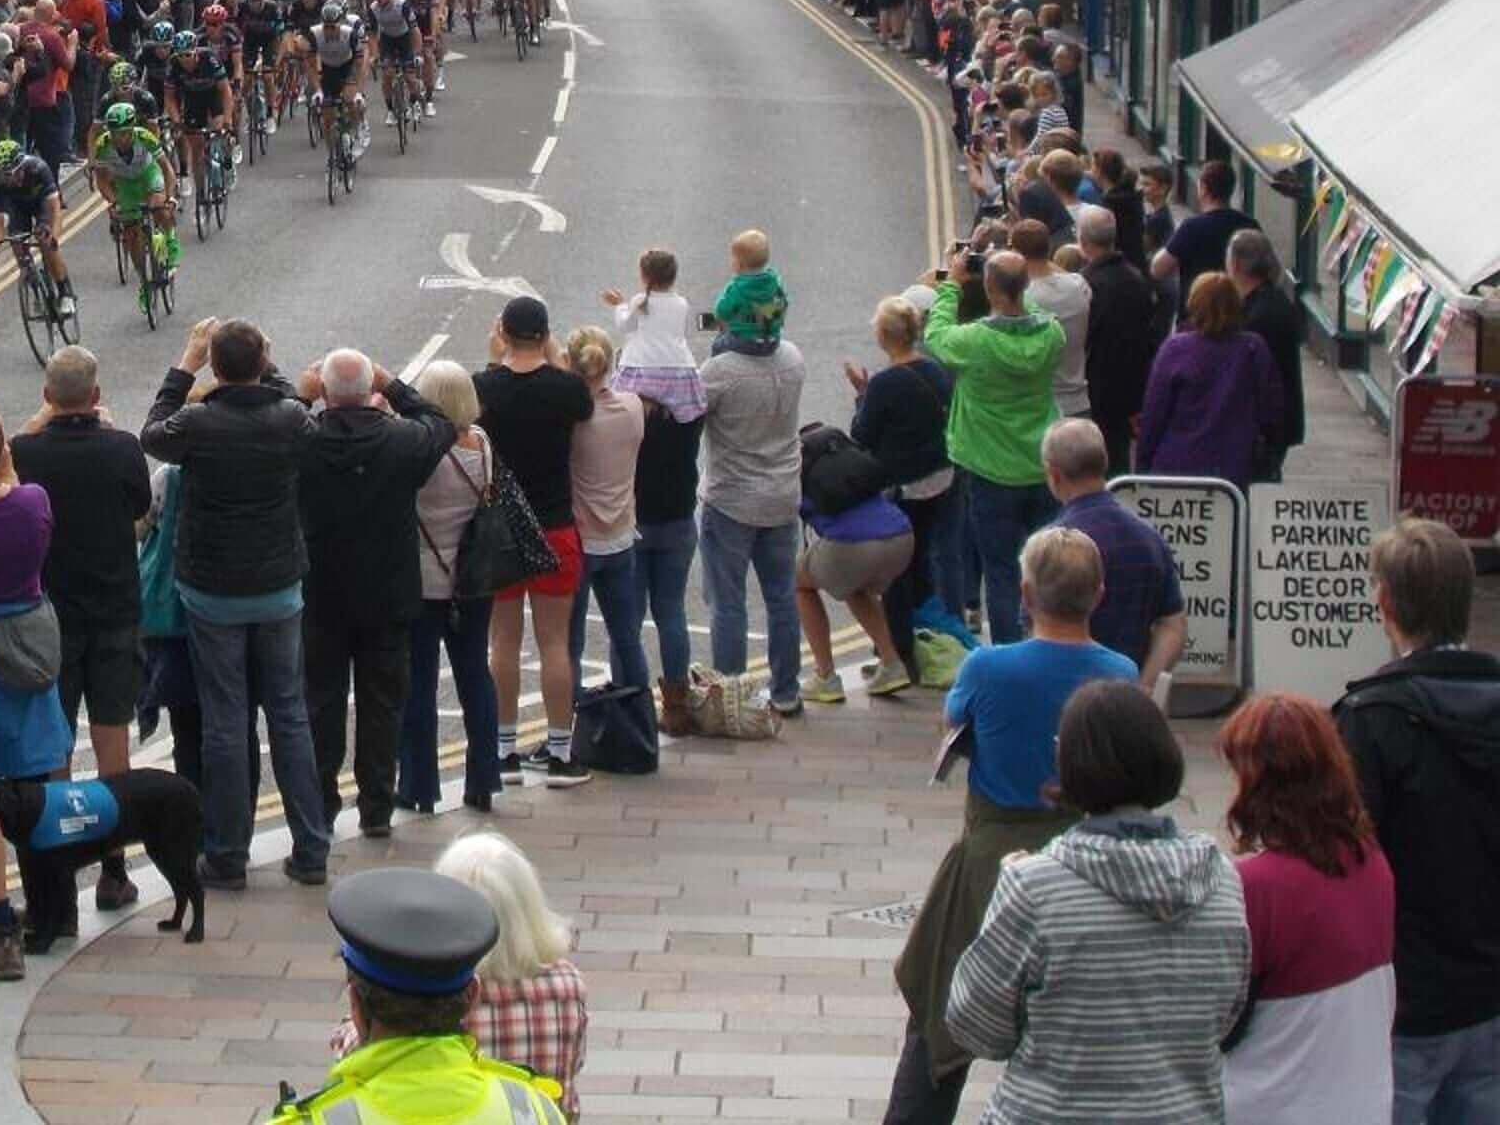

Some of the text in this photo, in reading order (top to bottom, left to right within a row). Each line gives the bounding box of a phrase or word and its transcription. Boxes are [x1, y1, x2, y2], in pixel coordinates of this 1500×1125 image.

[1138, 498, 1214, 521] SLATE
[1275, 499, 1369, 521] PRIVATE
[1403, 492, 1496, 511] FACTORY
[1159, 525, 1208, 546] GNS
[1271, 525, 1372, 546] PARKING
[1256, 549, 1370, 572] LAKELAN
[1283, 576, 1366, 598] DECOR
[1291, 627, 1353, 649] ONLY
